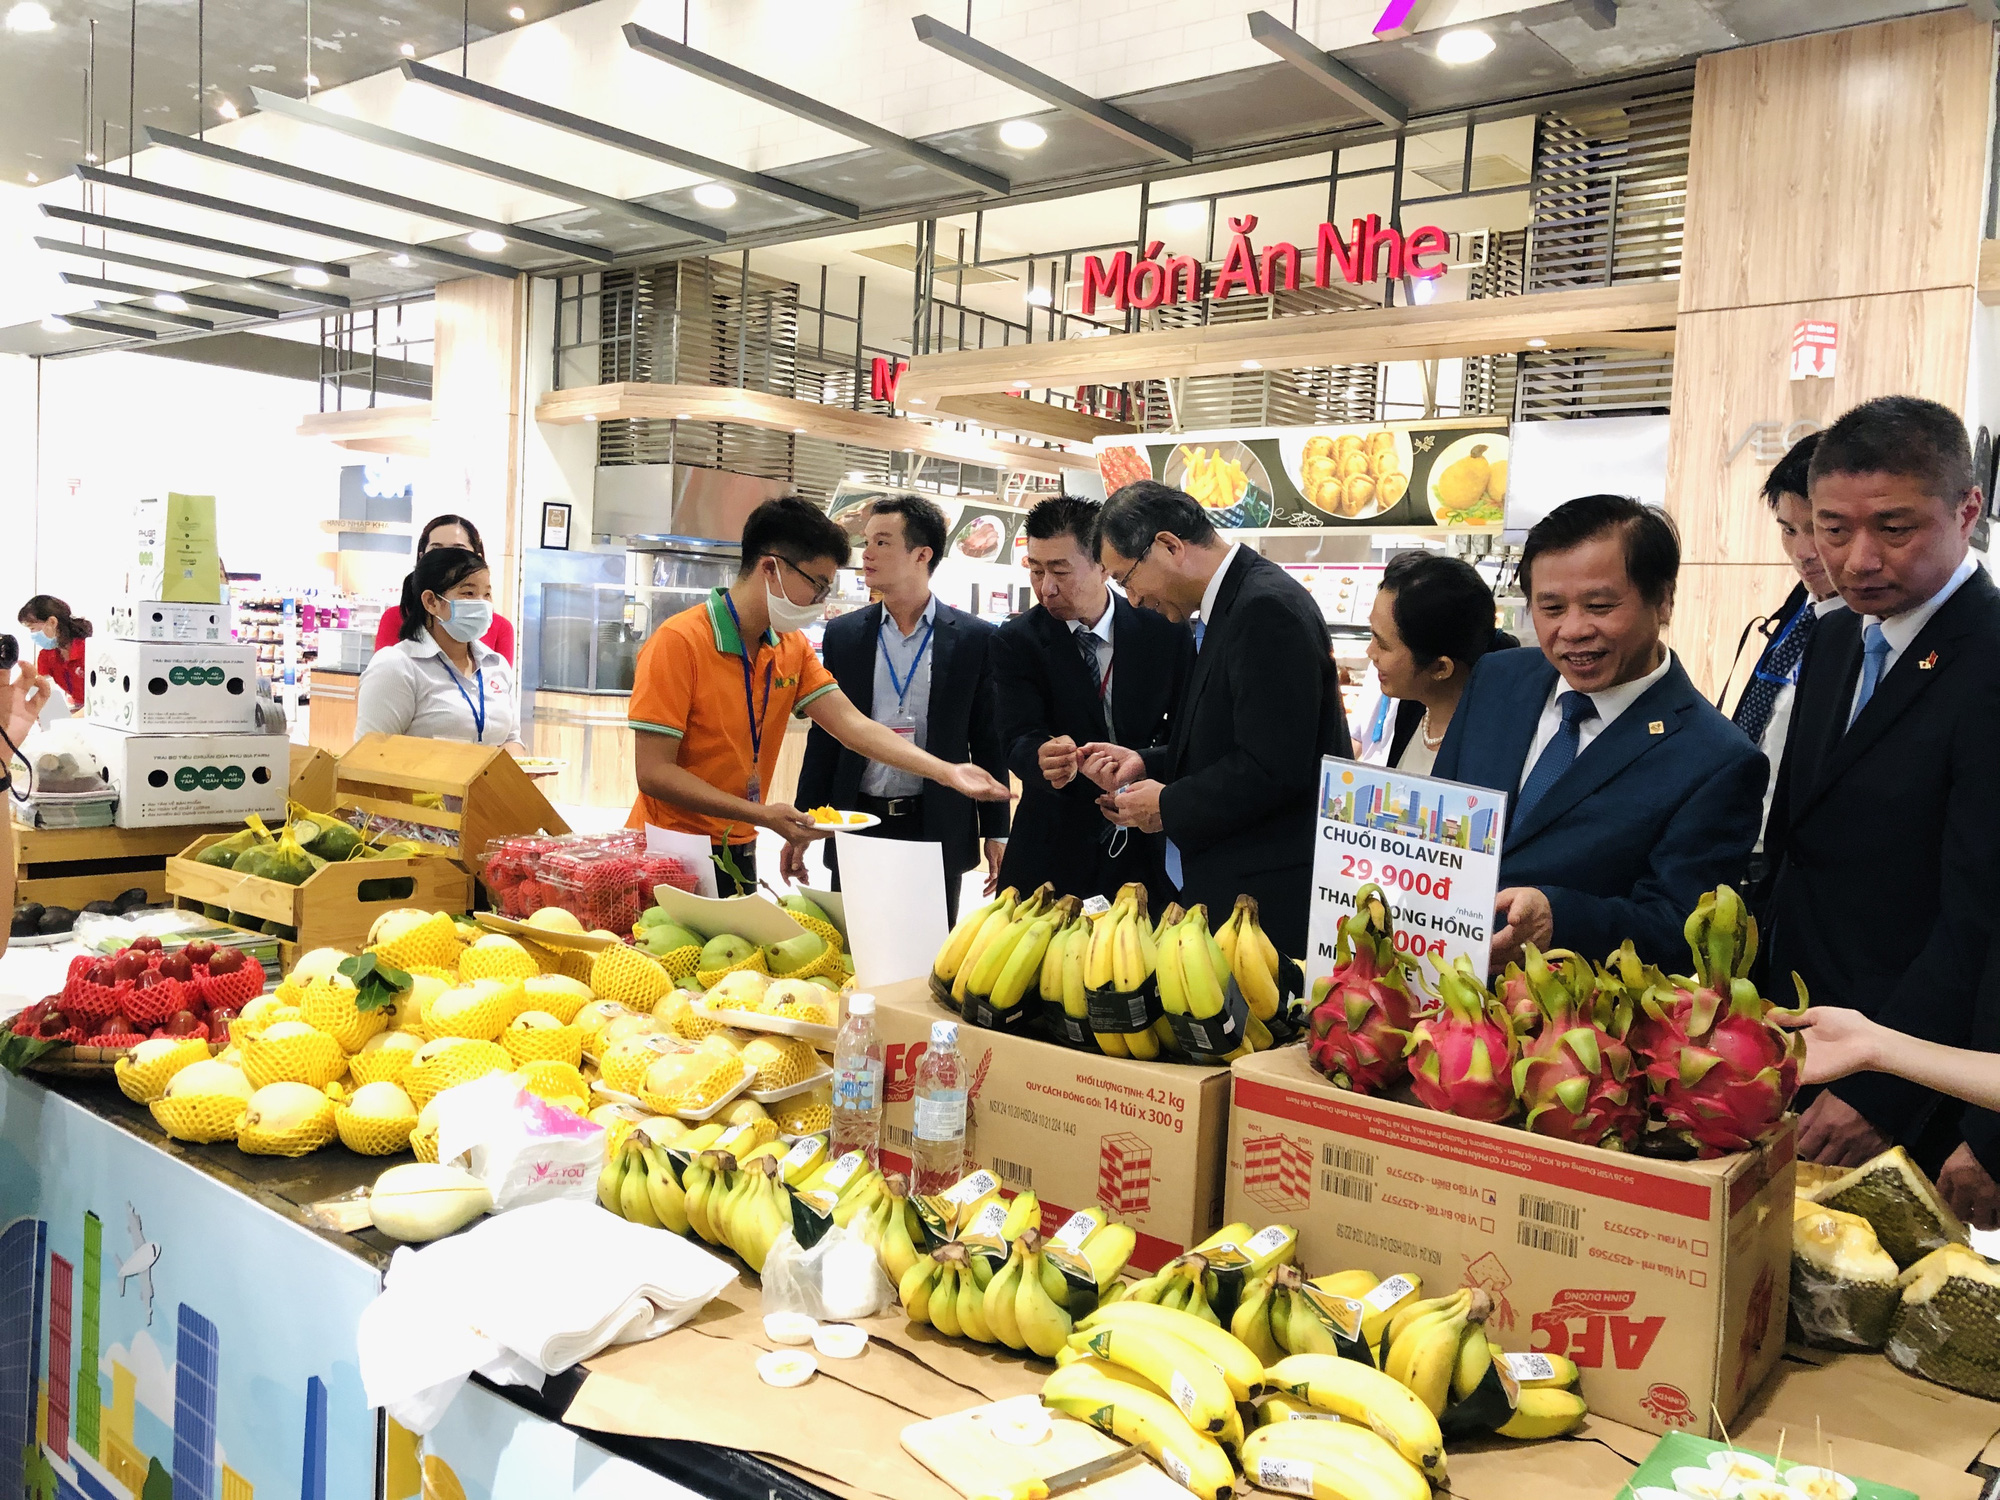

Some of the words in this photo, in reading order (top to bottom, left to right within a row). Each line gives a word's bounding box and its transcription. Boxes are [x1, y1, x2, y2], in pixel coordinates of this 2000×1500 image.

[1082, 240, 1200, 316] Món
[1213, 213, 1301, 299] Ăn
[1323, 825, 1376, 850] CHUỐI
[1380, 838, 1463, 870] BOLAVEN
[1340, 854, 1453, 902] 29.900đ
[1392, 905, 1427, 927] ONG
[1431, 916, 1485, 942] HỒNG
[1075, 1072, 1095, 1085] KHỐI
[1095, 1079, 1122, 1094] LƯỢNG
[1146, 1087, 1166, 1104] 4.2
[1168, 1092, 1185, 1112] kg
[1025, 1080, 1041, 1092] QUY
[1042, 1084, 1061, 1097] CÁCH
[1062, 1089, 1085, 1103] ĐÓNG
[1085, 1096, 1101, 1108] GÓI:
[1103, 1097, 1118, 1112] 14
[1119, 1101, 1136, 1117] túi
[1138, 1109, 1146, 1119] x
[1148, 1109, 1172, 1126] 300
[1173, 1118, 1183, 1133] g
[1386, 1166, 1424, 1183] 4257576
[1468, 1185, 1478, 1196] Vị
[1381, 1193, 1419, 1210] 4257577
[1467, 1213, 1476, 1225] Vị
[1603, 1220, 1649, 1239] 4257573
[1656, 1233, 1674, 1244] rau
[1676, 1236, 1688, 1249] Vị
[1588, 1247, 1634, 1265] 4257569
[1676, 1266, 1686, 1279] Vị
[1603, 1293, 1629, 1302] DINH
[1530, 1313, 1667, 1370] AFC
